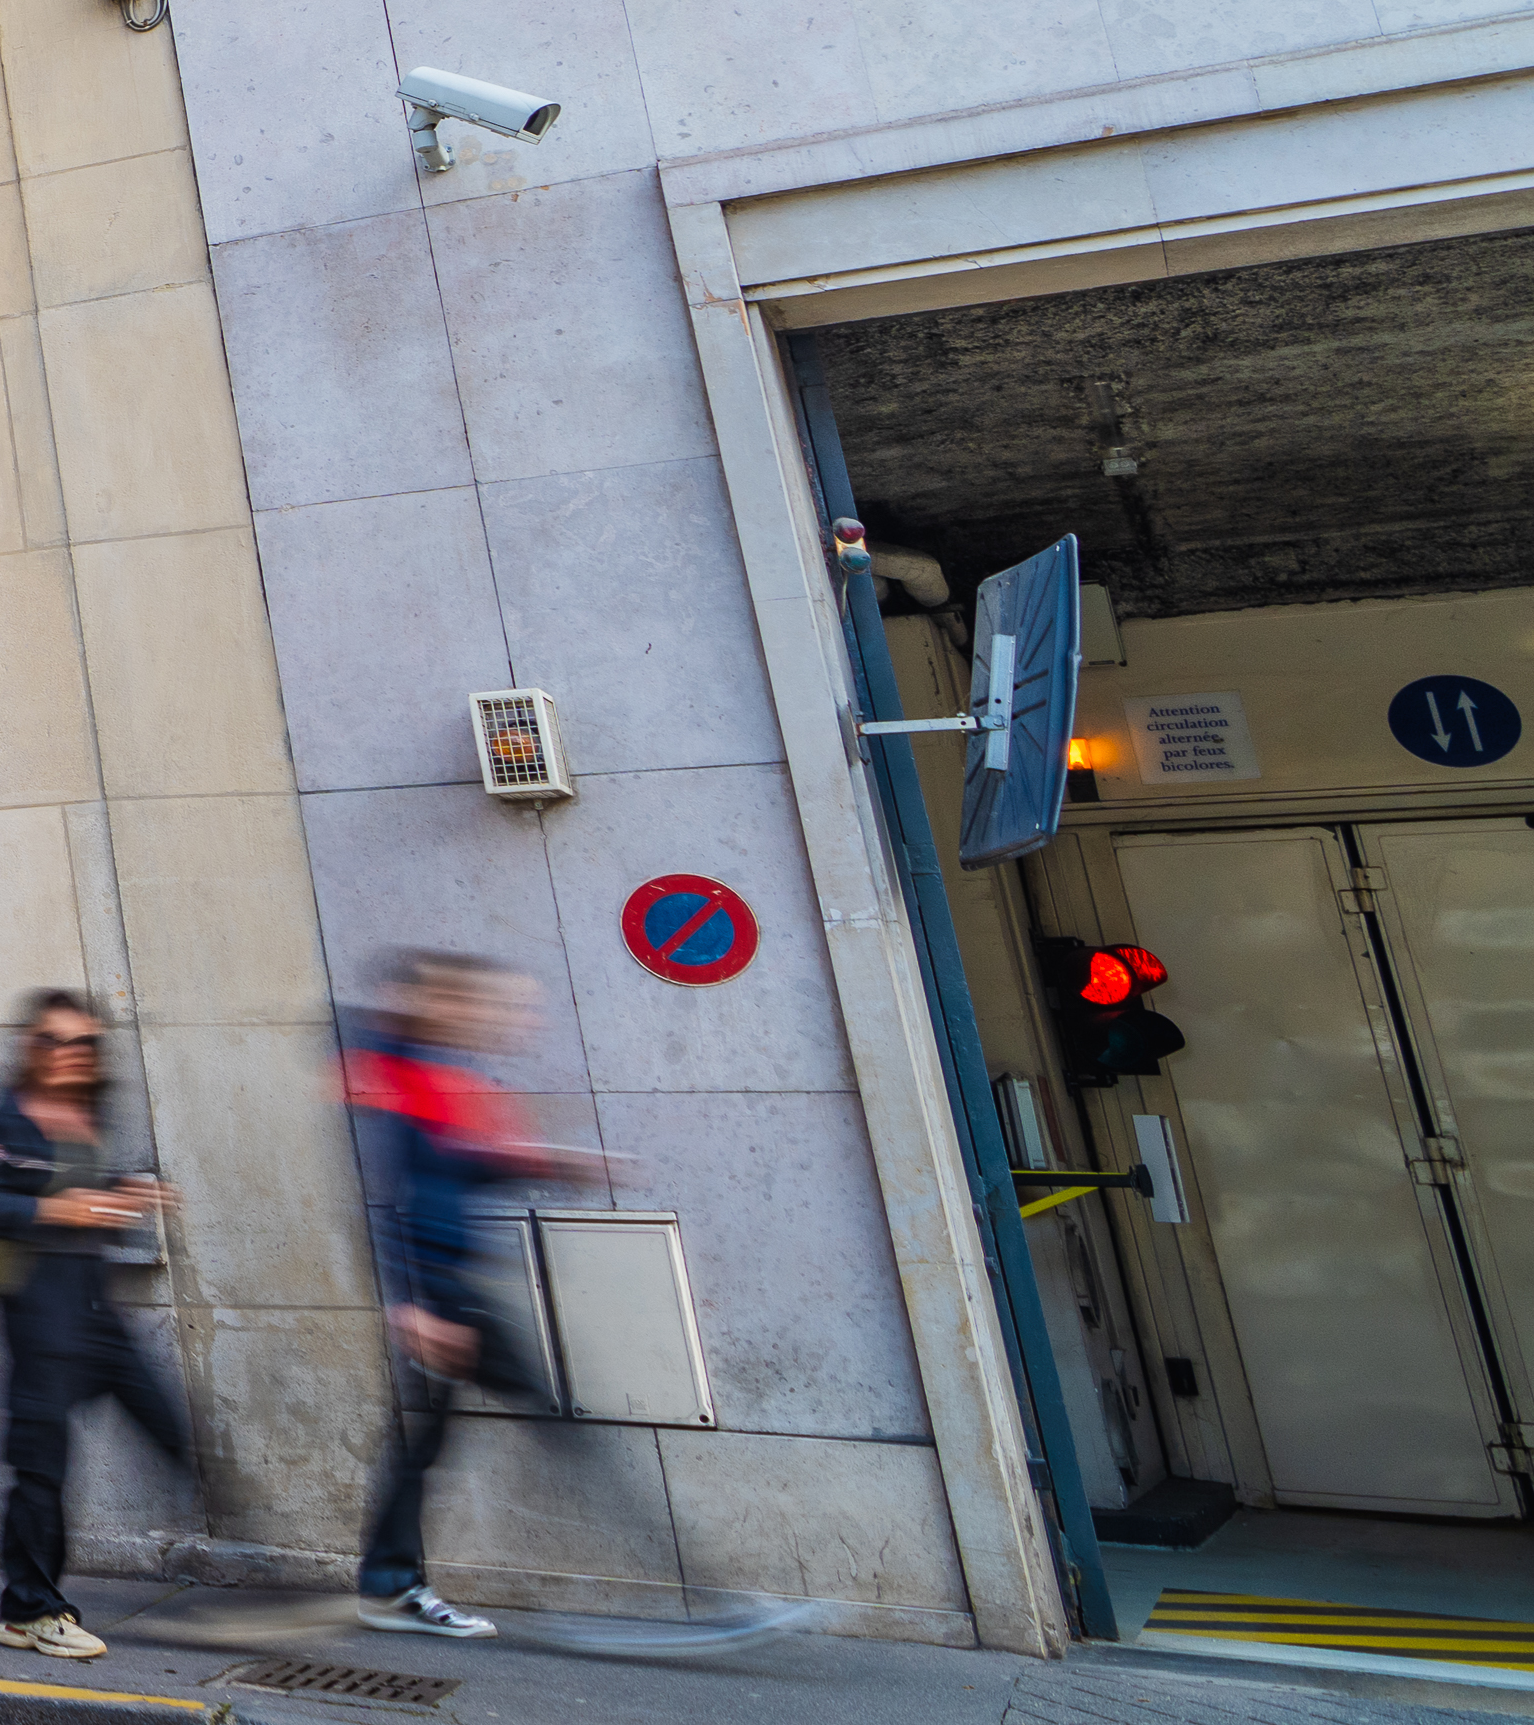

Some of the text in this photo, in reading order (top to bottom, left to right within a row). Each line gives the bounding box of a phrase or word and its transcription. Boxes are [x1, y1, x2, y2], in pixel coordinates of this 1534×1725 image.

[1148, 704, 1221, 718] Attention
[1146, 717, 1229, 732] circulation
[1163, 745, 1226, 761] par feux
